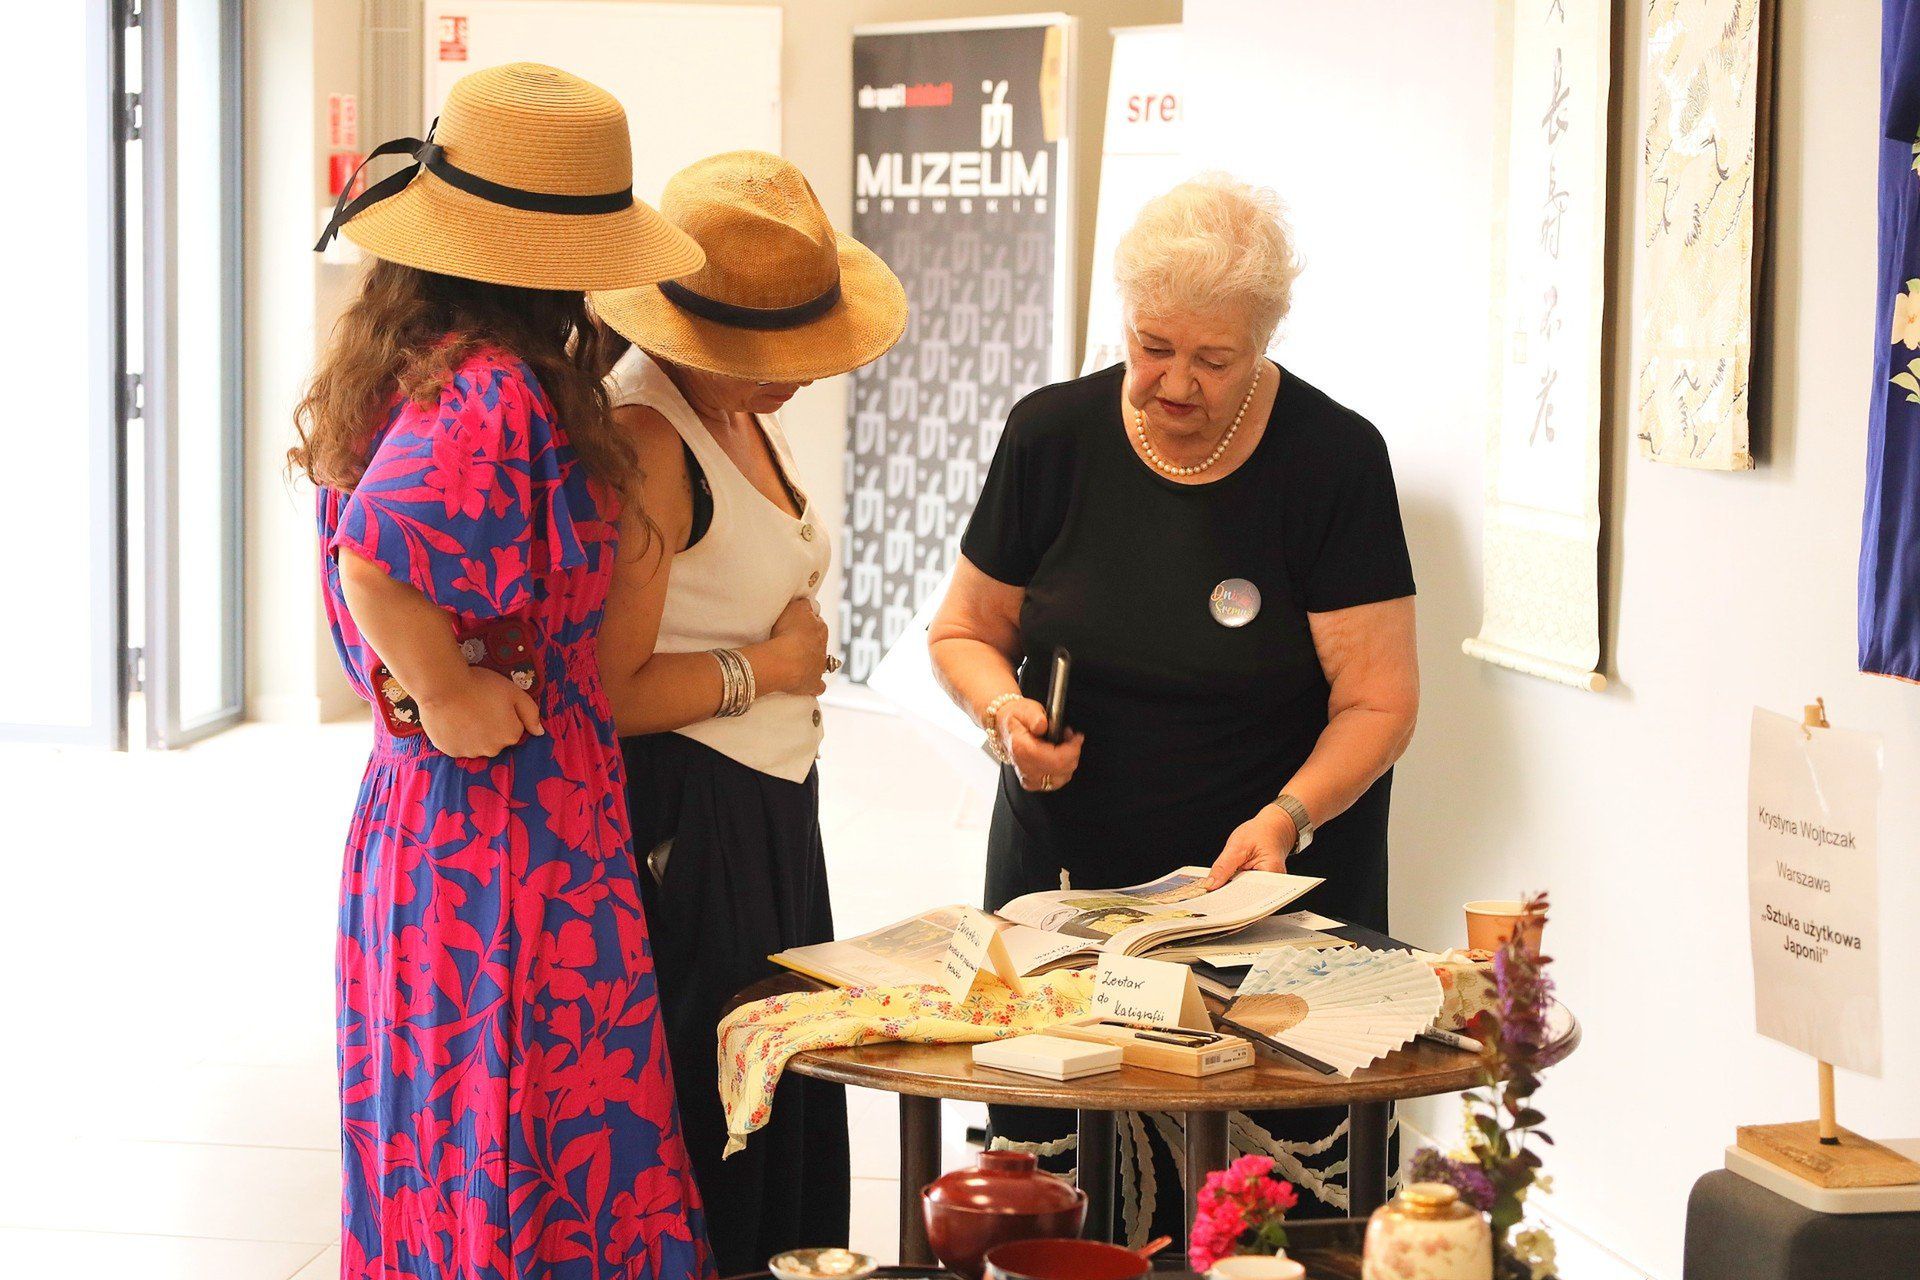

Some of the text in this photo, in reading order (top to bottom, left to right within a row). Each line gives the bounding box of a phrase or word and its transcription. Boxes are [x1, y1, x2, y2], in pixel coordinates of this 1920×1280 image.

[1126, 94, 1178, 122] sre
[857, 150, 1049, 198] MUZEUM
[1758, 805, 1857, 849] Krystyna Wojtczak
[1776, 860, 1831, 893] Warszawa
[1803, 919, 1862, 950] użytkowa
[1097, 993, 1109, 1004] do
